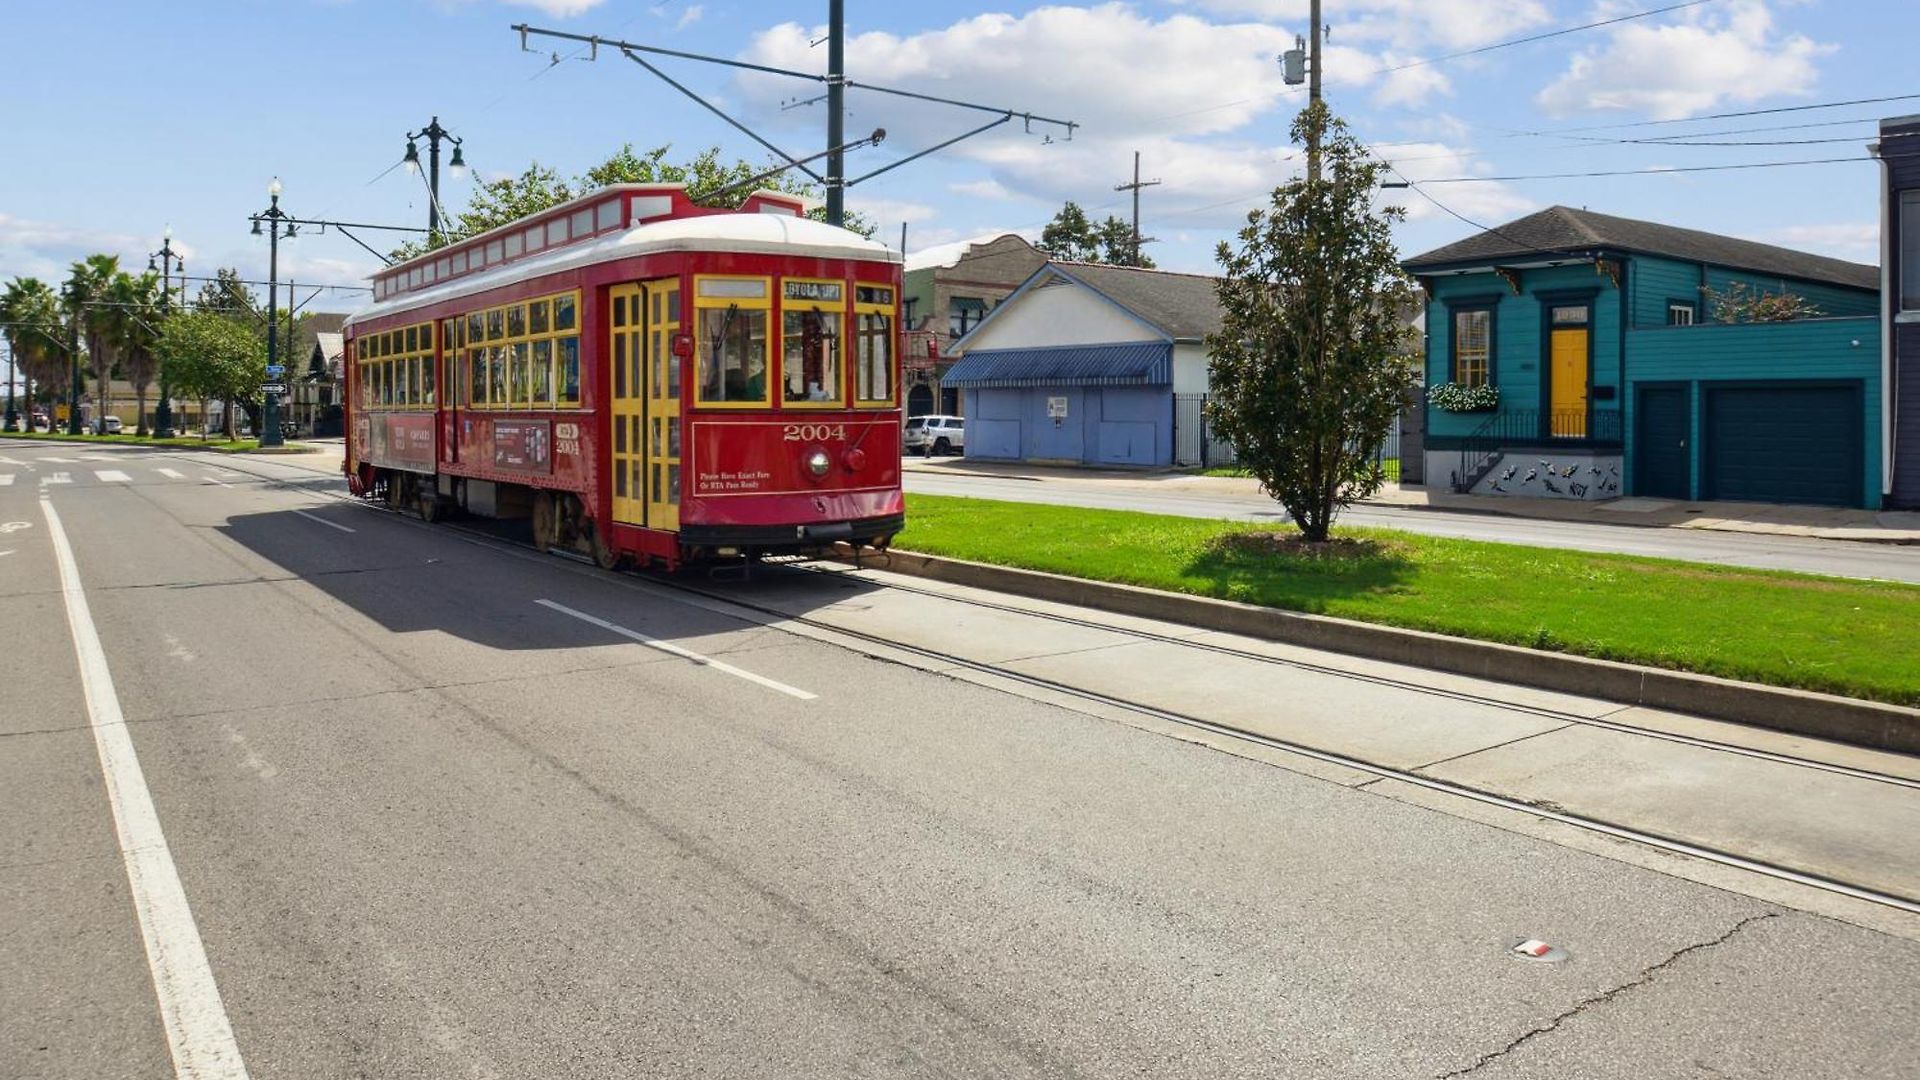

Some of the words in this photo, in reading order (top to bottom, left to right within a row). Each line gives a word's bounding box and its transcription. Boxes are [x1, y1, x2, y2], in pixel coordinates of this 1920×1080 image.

[783, 424, 847, 441] 2004
[700, 472, 719, 480] Please
[738, 471, 755, 479] Exact
[757, 471, 770, 479] Fare
[741, 481, 759, 489] Ready
